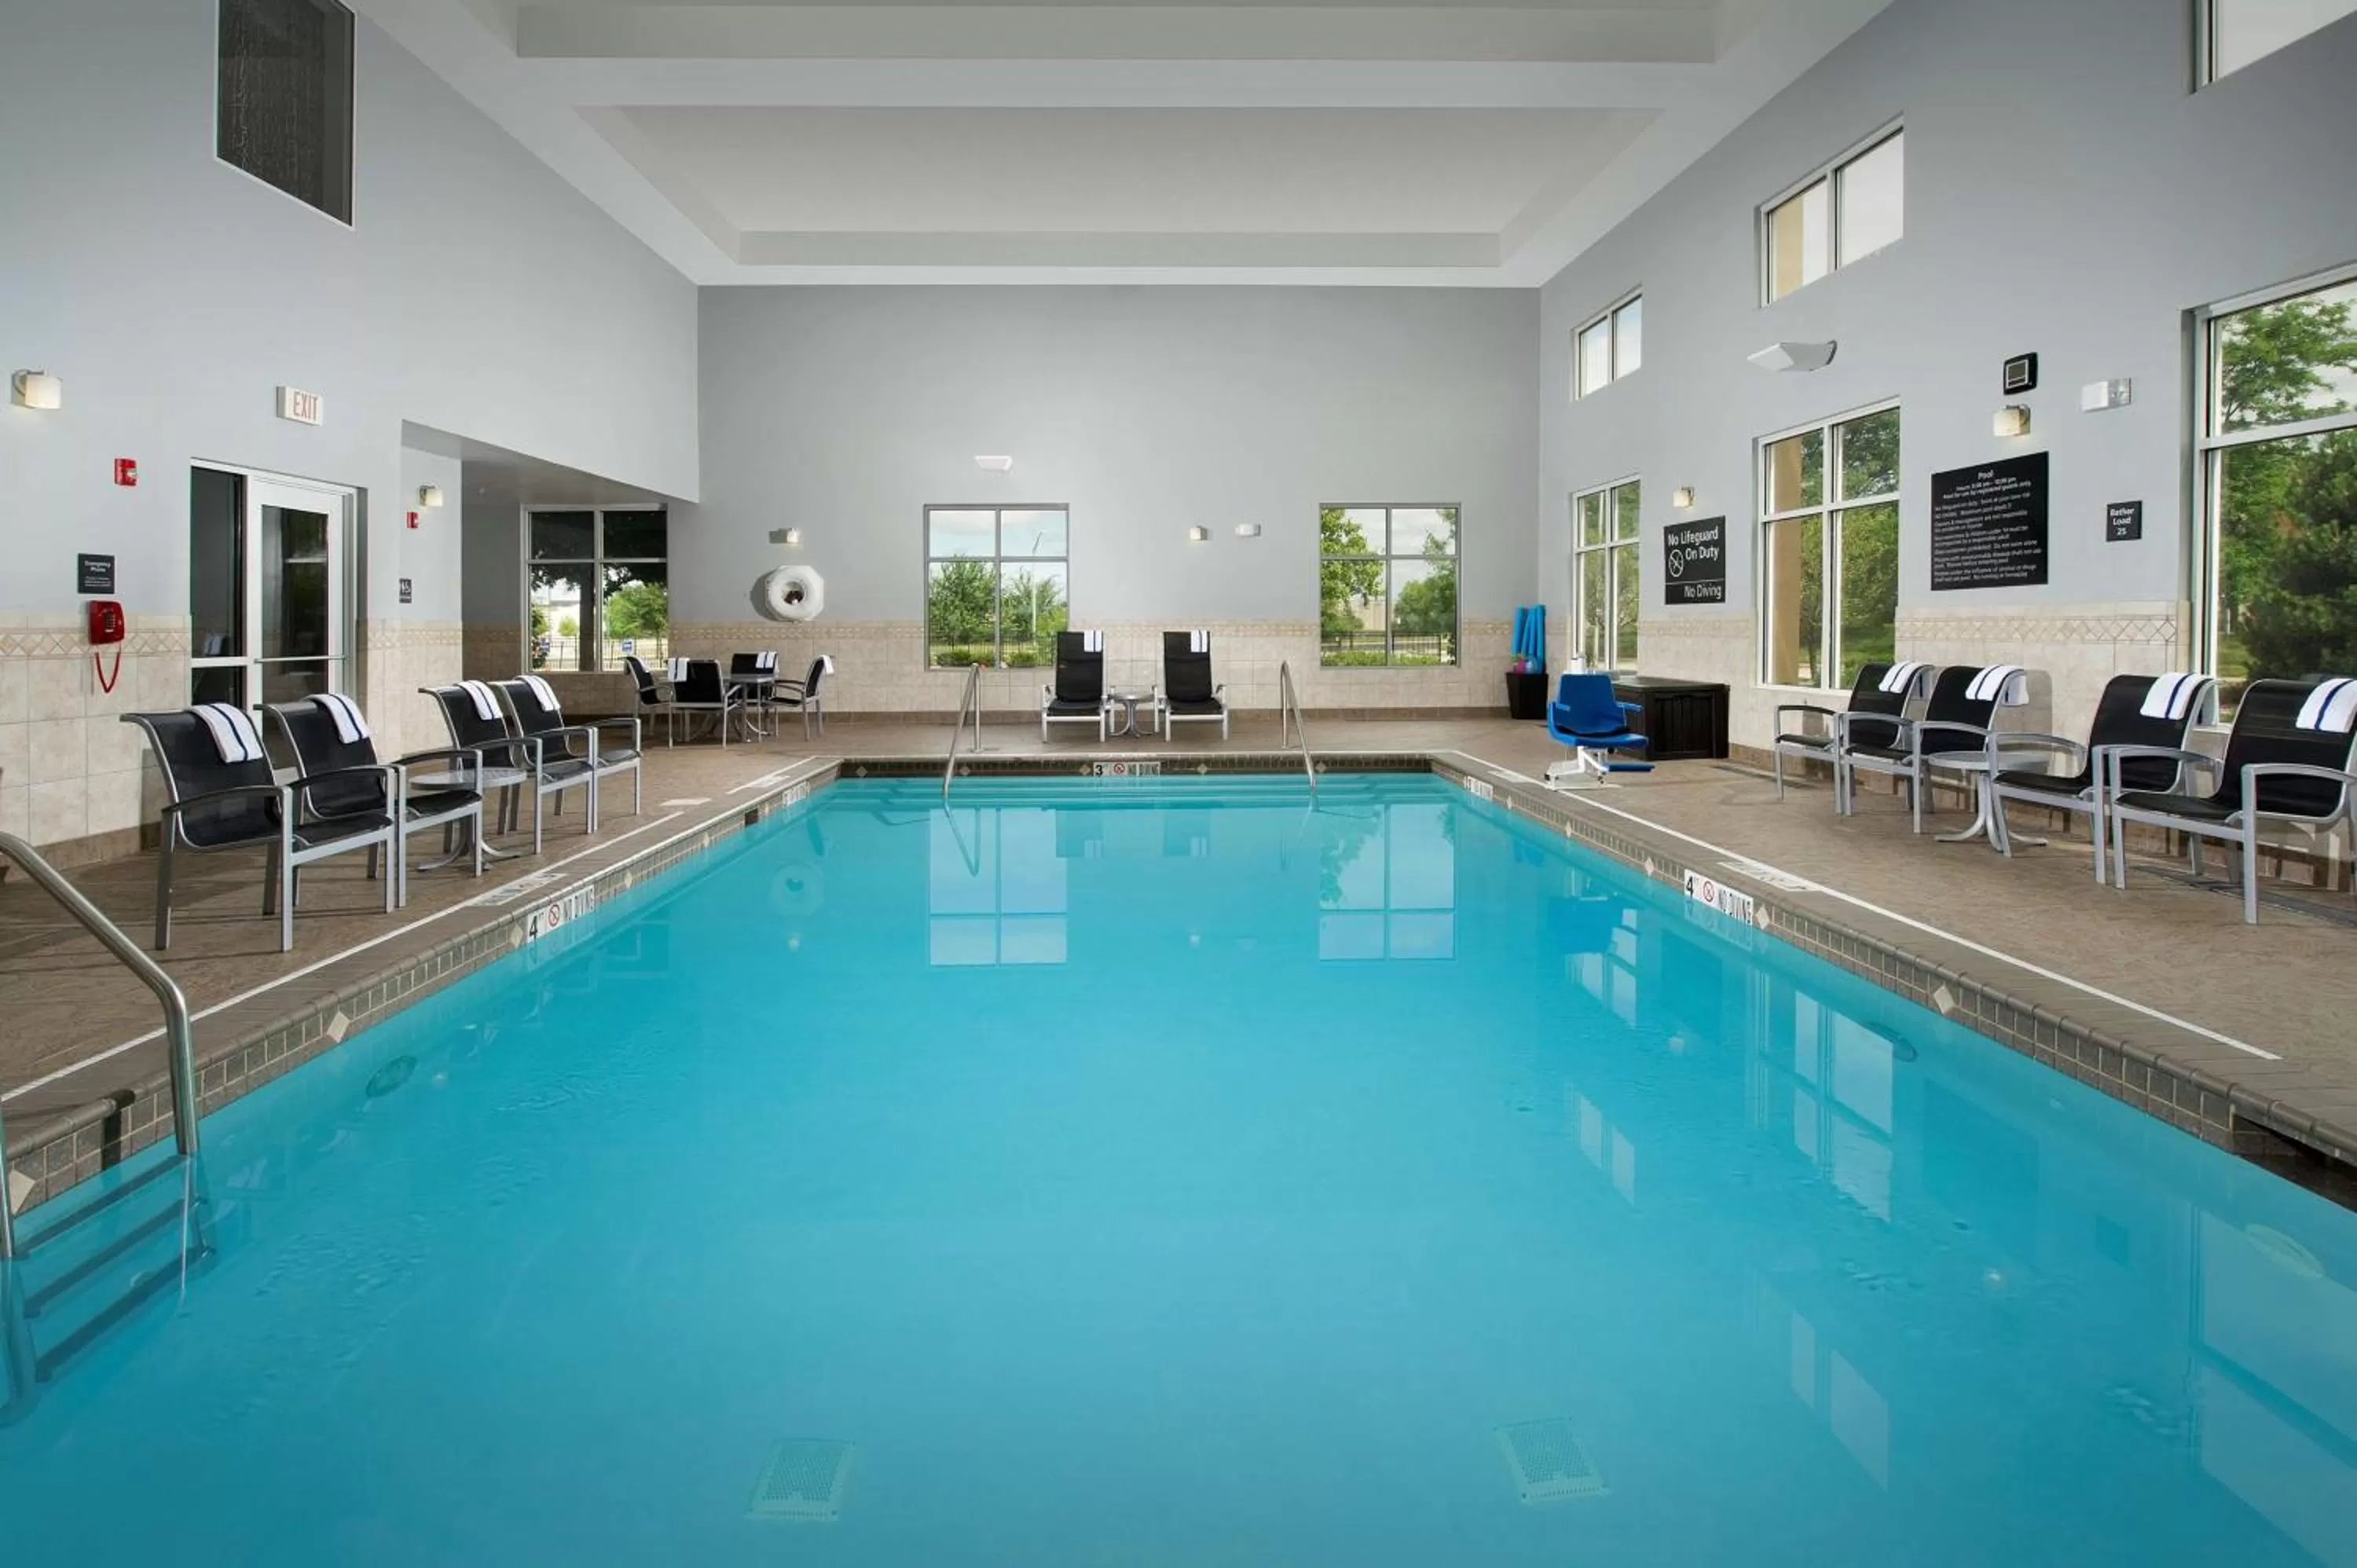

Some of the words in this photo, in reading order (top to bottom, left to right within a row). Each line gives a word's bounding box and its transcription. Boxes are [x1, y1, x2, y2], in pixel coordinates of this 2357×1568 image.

[293, 391, 318, 422] EXIT
[2113, 516, 2131, 526] Load
[1668, 534, 1679, 547] No
[1681, 525, 1718, 545] Lifeguard
[1685, 548, 1697, 560] On
[1699, 545, 1719, 561] Duty
[1684, 585, 1695, 598] No
[1697, 582, 1721, 599] Diving
[1095, 764, 1103, 776] 3
[1685, 876, 1694, 897] 4
[529, 915, 538, 940] 4
